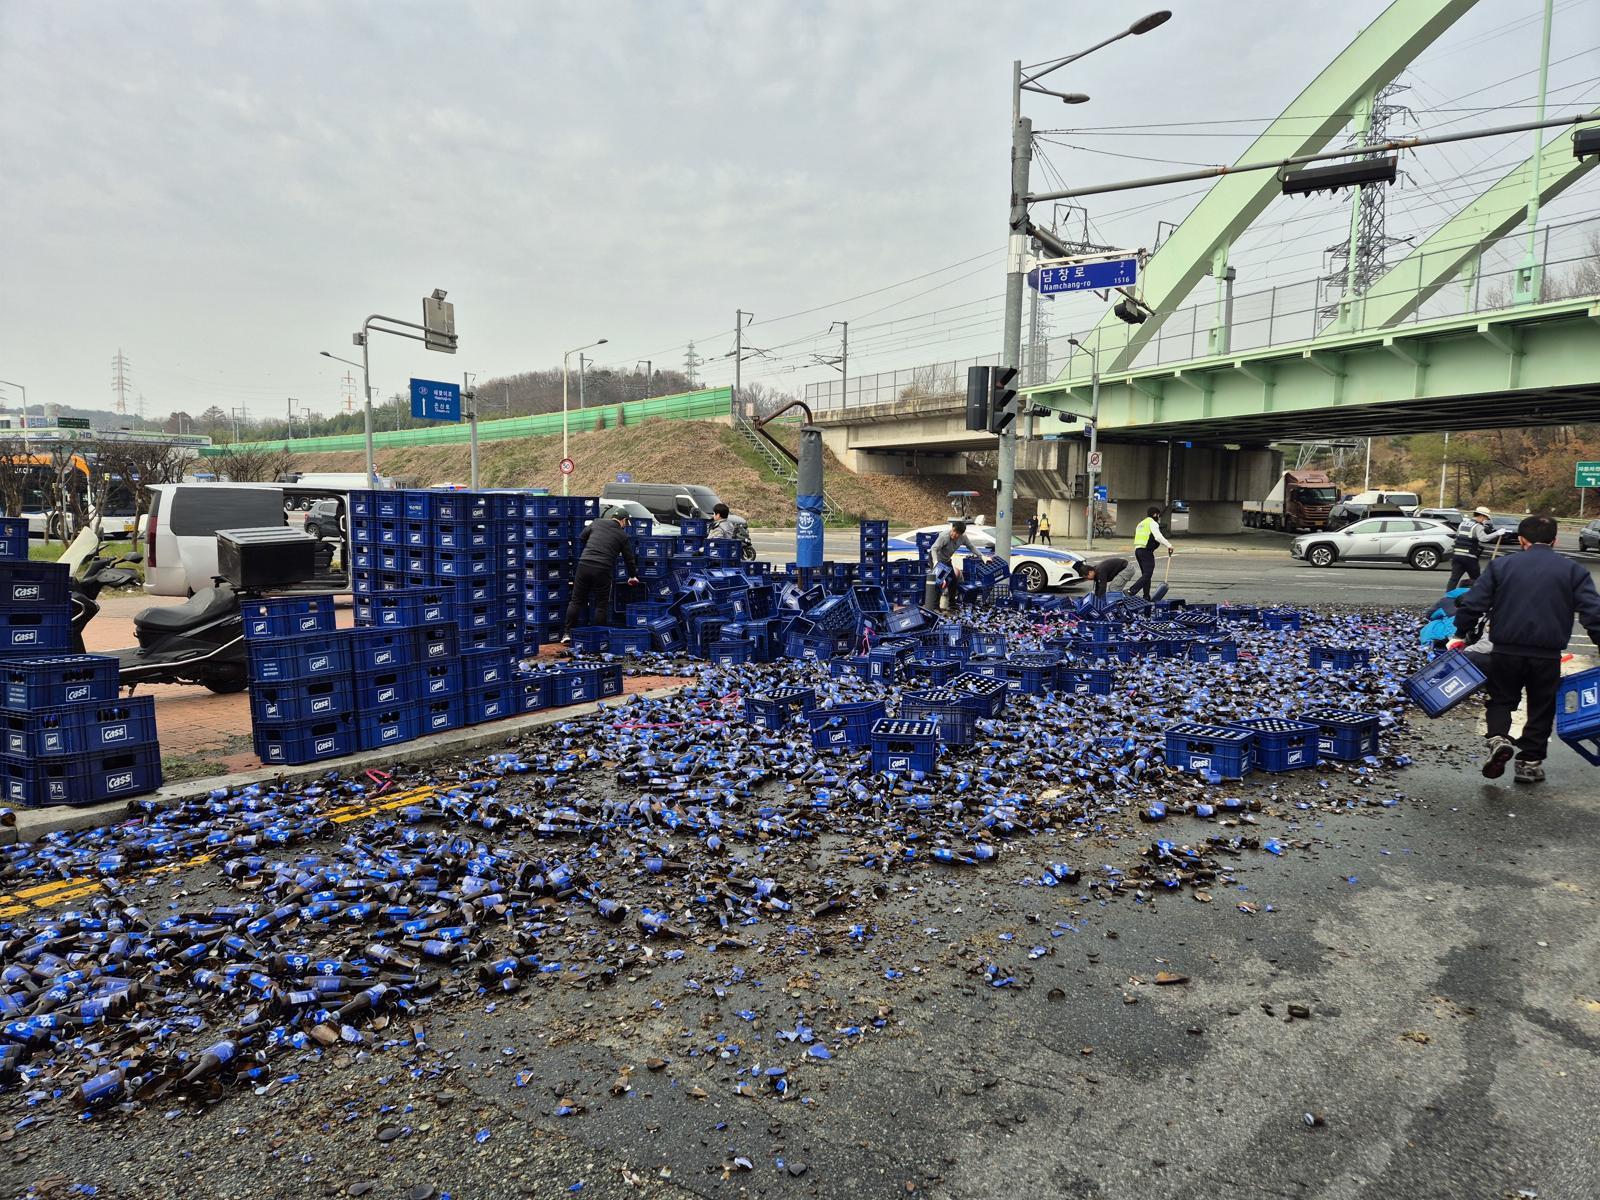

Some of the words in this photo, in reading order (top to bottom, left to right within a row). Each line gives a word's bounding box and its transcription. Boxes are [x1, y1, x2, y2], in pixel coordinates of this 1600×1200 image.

[1042, 266, 1085, 283] 남창로
[1114, 276, 1130, 284] 1516
[1043, 280, 1091, 291] Namchang-ro
[15, 586, 38, 598] Cass
[426, 610, 438, 619] Cass
[302, 619, 315, 629] Cass
[14, 632, 35, 642] Cass
[430, 645, 444, 655] Cass
[377, 653, 390, 662] Cass
[312, 658, 326, 669] Cass
[485, 671, 497, 680] Cass
[431, 681, 444, 691] Cass
[68, 687, 88, 699] Cass
[379, 690, 392, 700] Cass
[313, 700, 329, 710] Cass
[485, 704, 497, 714] Cass
[433, 716, 446, 726] Cass
[104, 727, 124, 740] Cass
[383, 728, 396, 738] Cass
[831, 732, 844, 742] Cass
[317, 741, 332, 752] Cass
[1289, 753, 1301, 762] Cass
[892, 759, 906, 768] Cass
[1192, 759, 1209, 768] Cass
[109, 774, 131, 789] Cass
[50, 784, 62, 792] 카스
